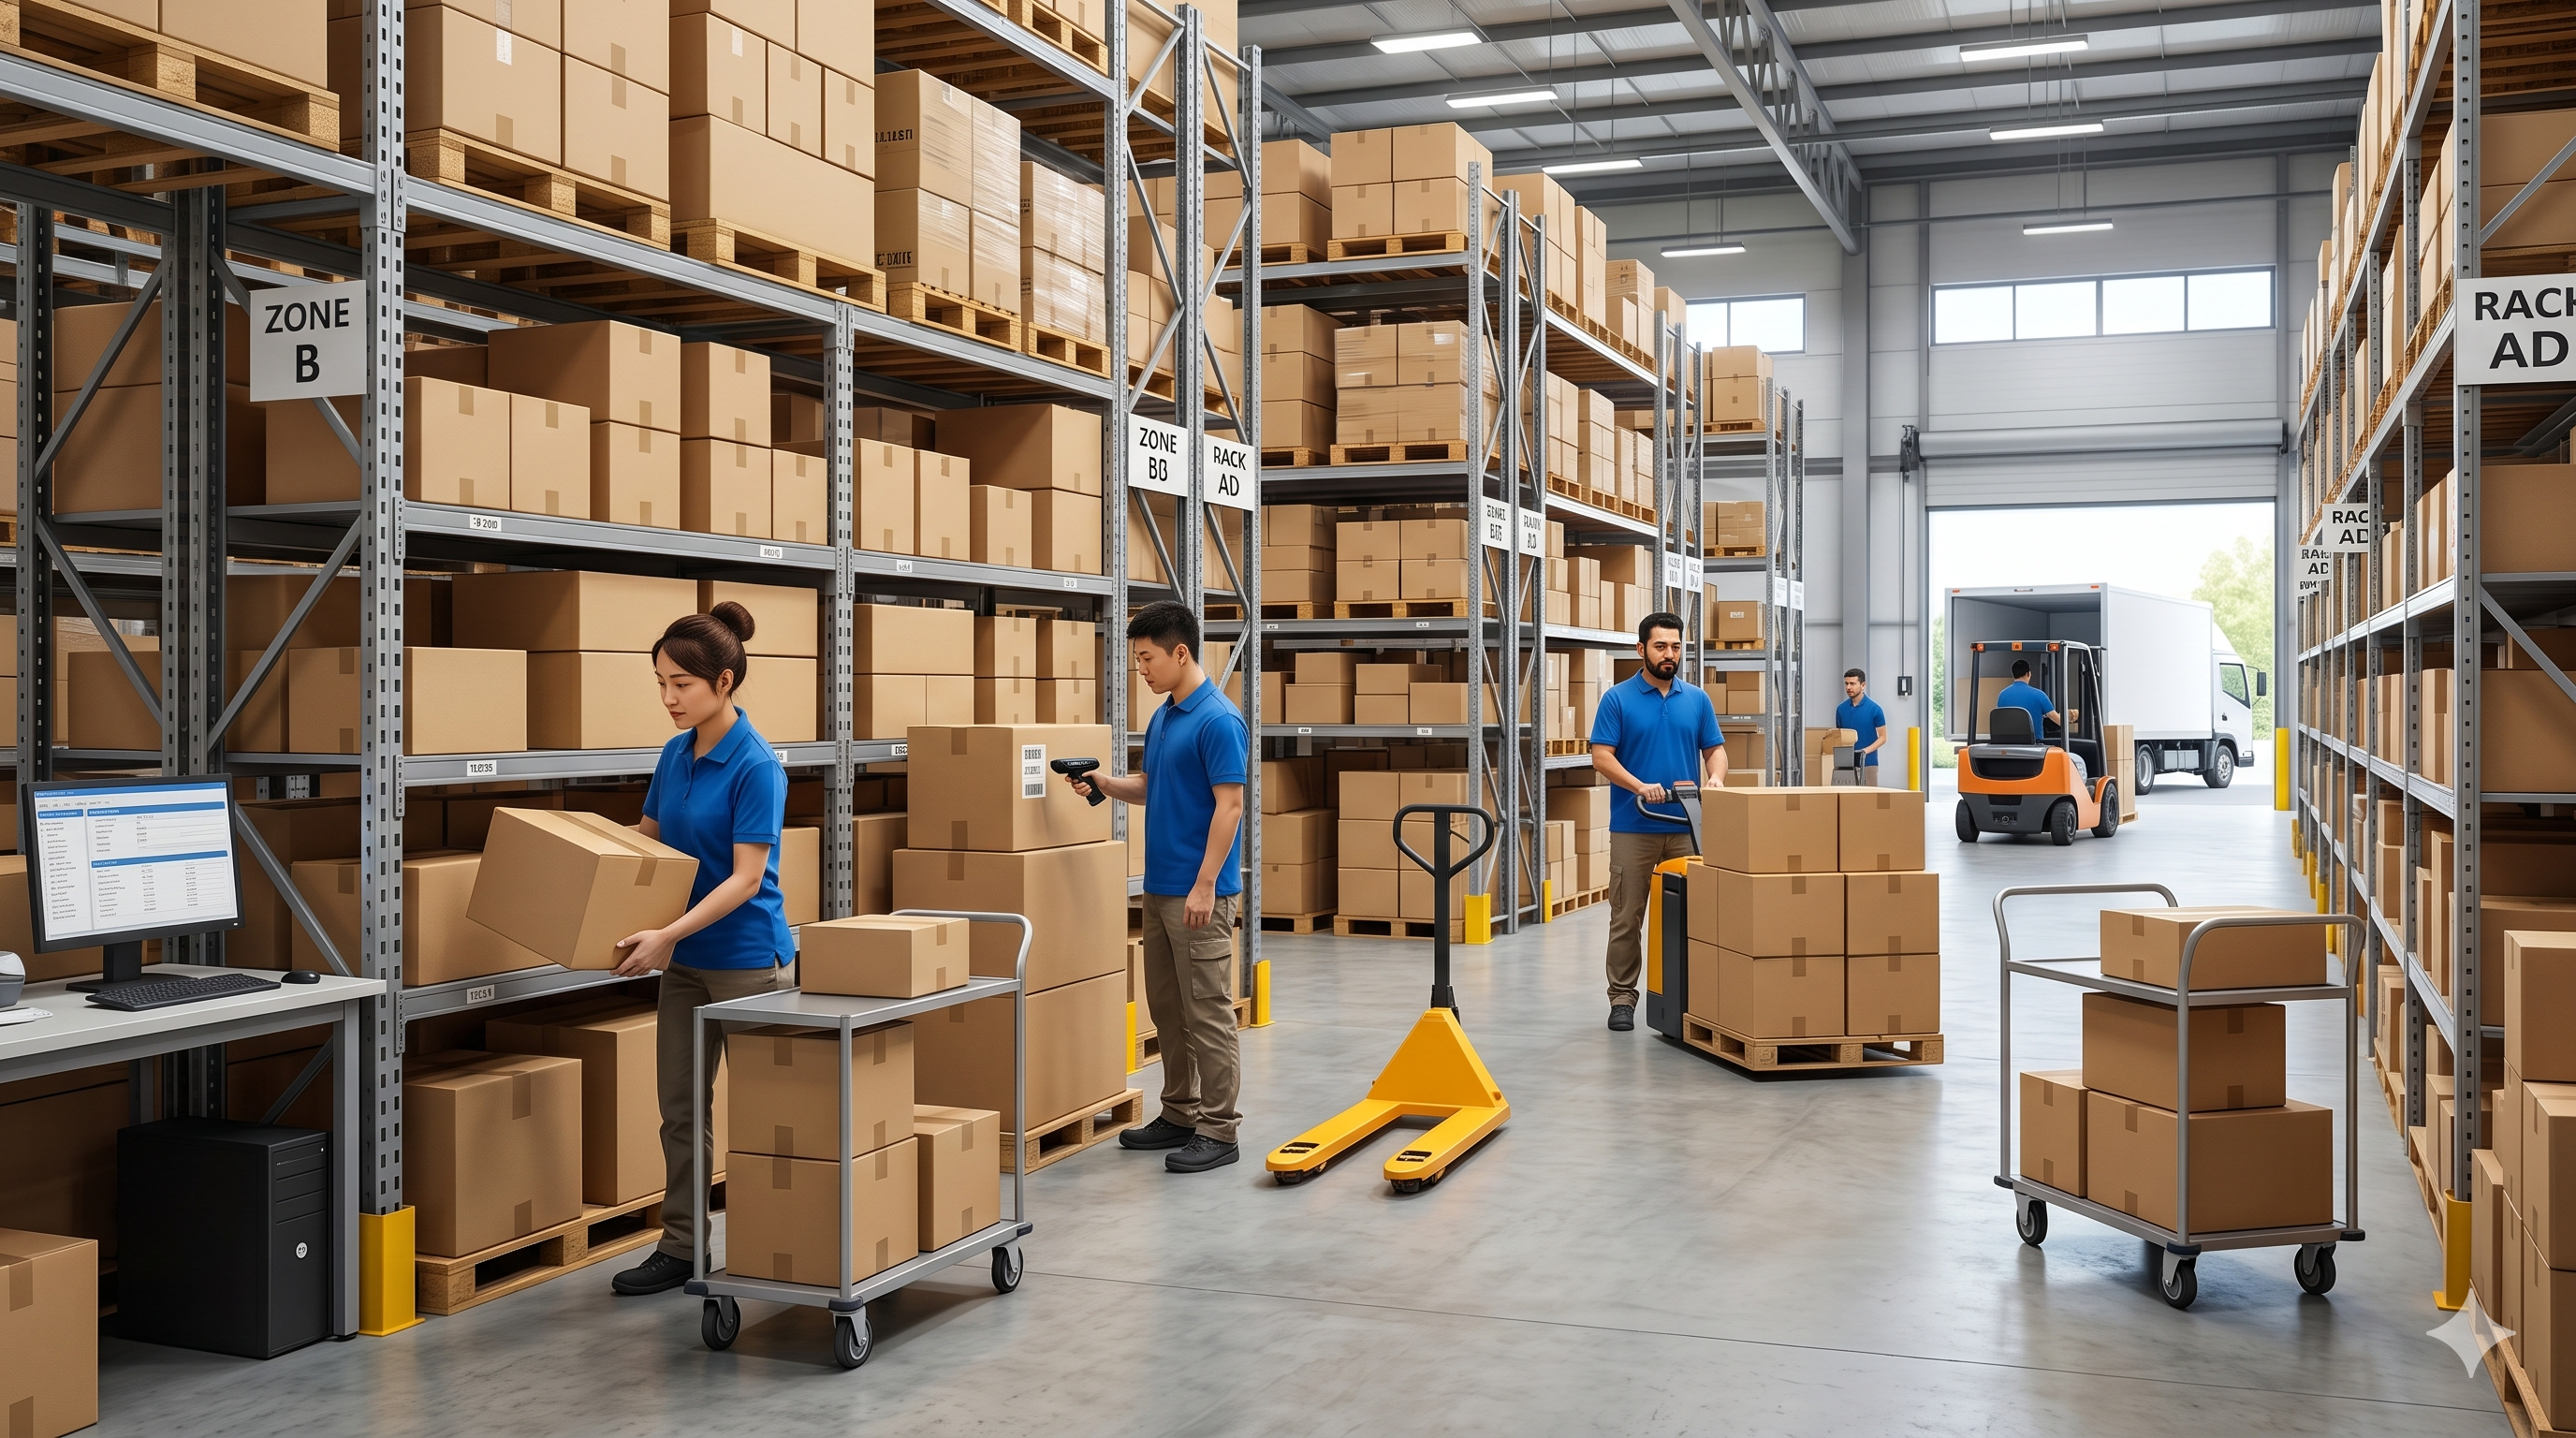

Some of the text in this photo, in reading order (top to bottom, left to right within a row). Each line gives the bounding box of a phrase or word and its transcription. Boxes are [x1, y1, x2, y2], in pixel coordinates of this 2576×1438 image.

[265, 298, 350, 333] ZONE
[2489, 330, 2569, 369] AD
[296, 344, 320, 383] B
[1139, 427, 1177, 454] ZONE
[1214, 446, 1246, 470] RACK
[1218, 473, 1239, 496] AD
[2332, 509, 2368, 523] RAC
[2338, 529, 2368, 544] AD
